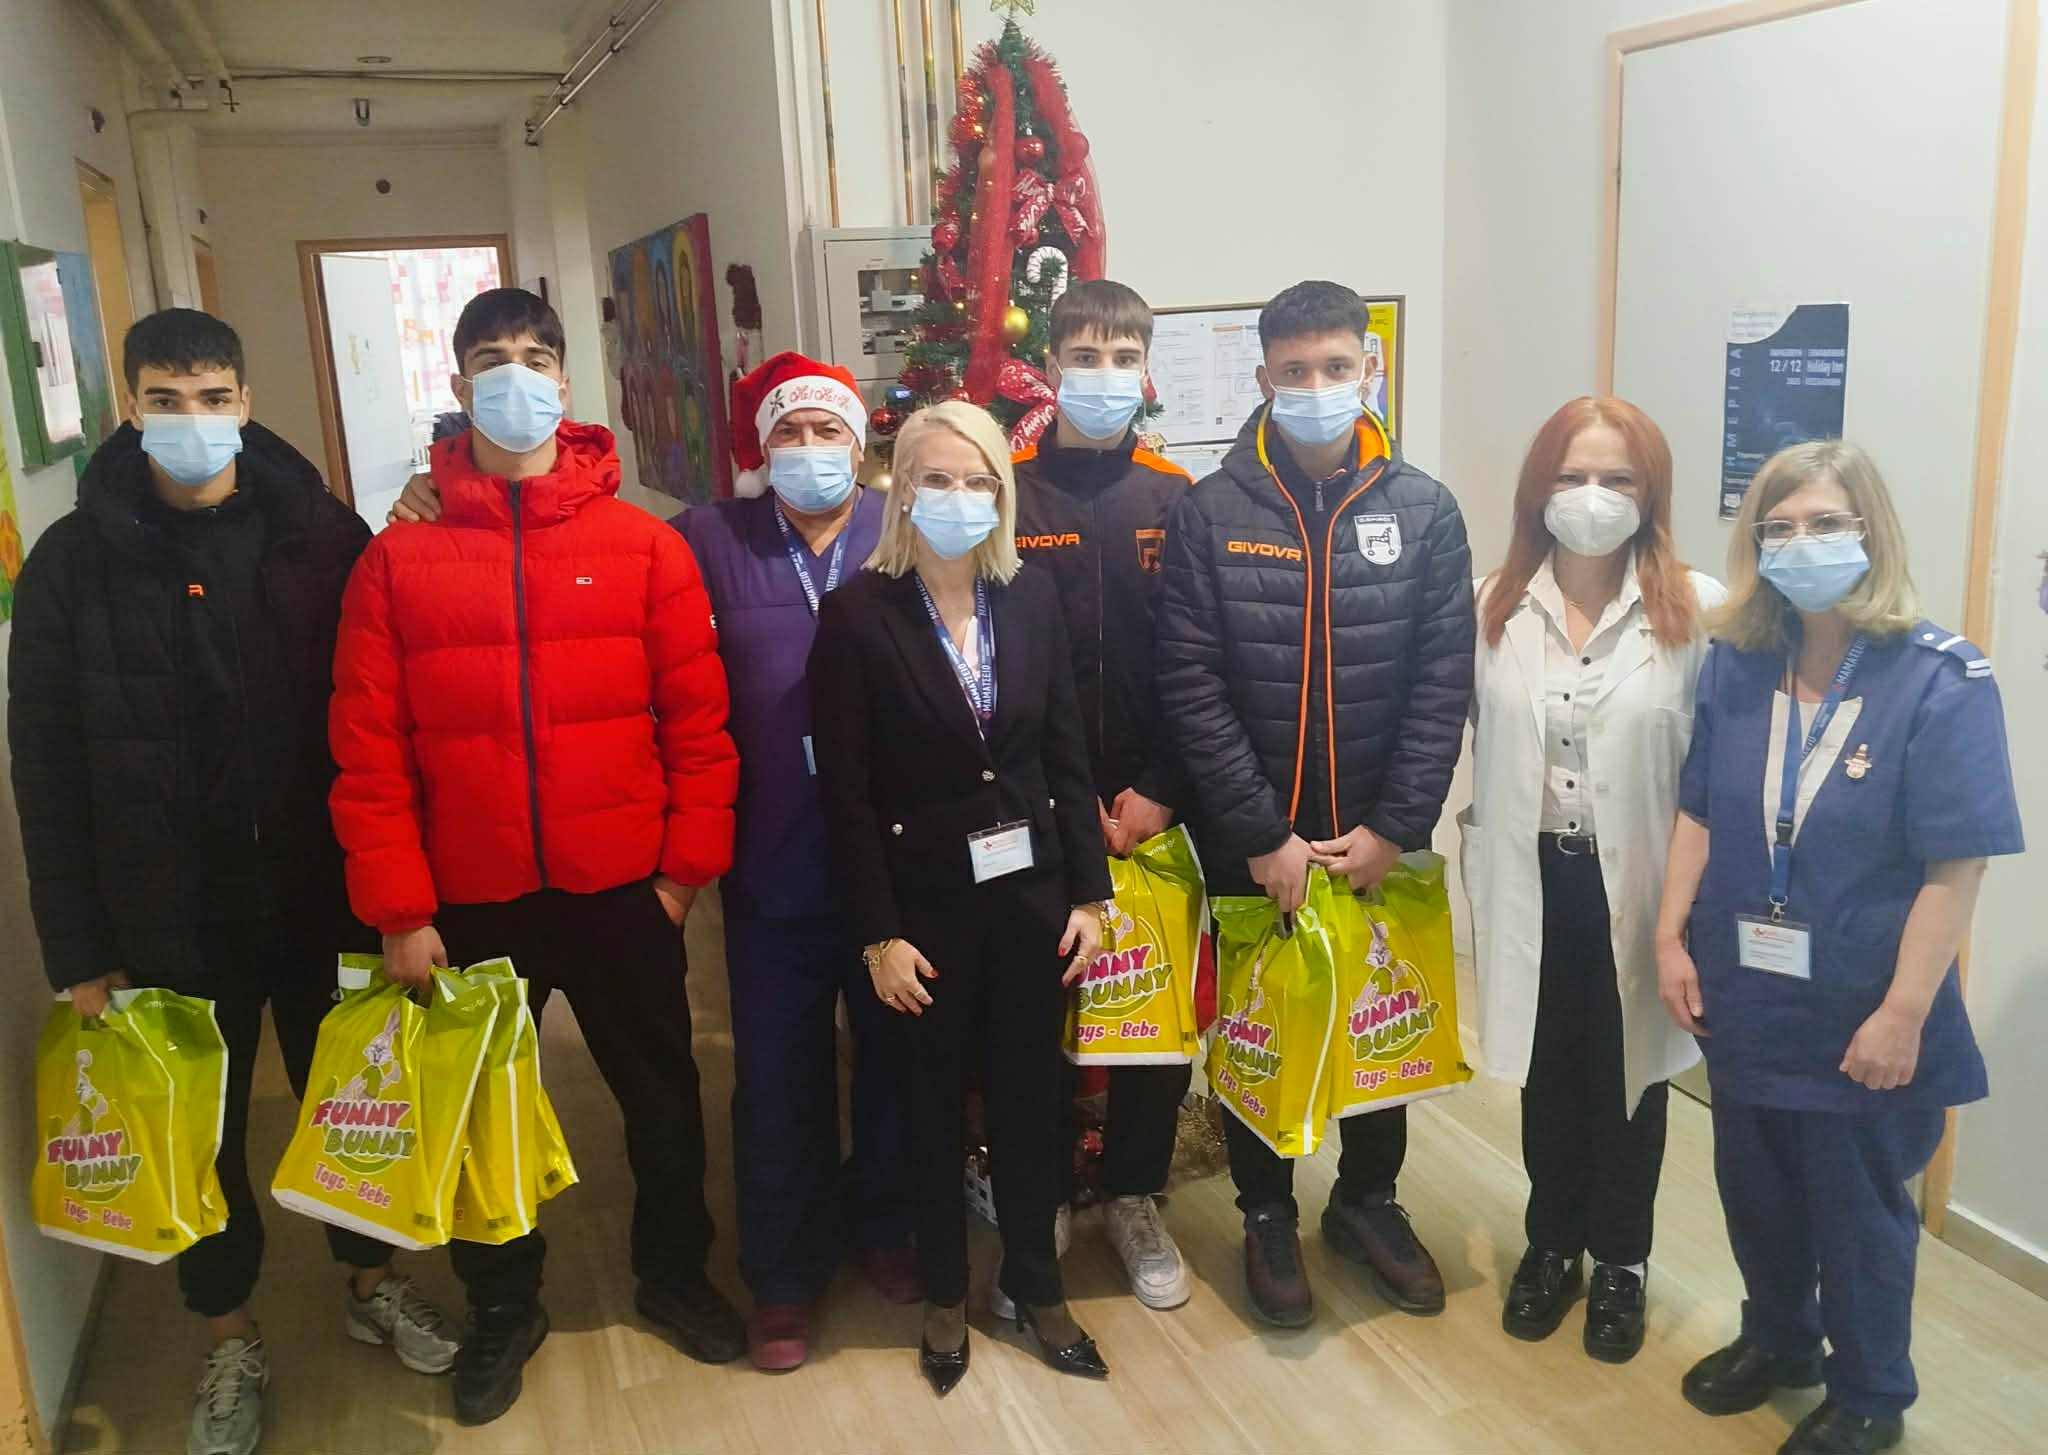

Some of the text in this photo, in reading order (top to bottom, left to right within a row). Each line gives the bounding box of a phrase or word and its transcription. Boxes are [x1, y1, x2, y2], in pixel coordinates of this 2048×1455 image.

[1228, 541, 1302, 561] GIVOVA
[1120, 1020, 1159, 1038] Bebe
[1355, 1001, 1440, 1061] BUNNY
[1354, 1069, 1388, 1091] Toys
[1400, 1059, 1434, 1078] Bebe
[310, 1100, 412, 1128] FUNNY
[1240, 1089, 1267, 1118] Bebe
[324, 1127, 418, 1158] BUNNY
[314, 1161, 349, 1191] Toys
[357, 1180, 394, 1208] Bebe
